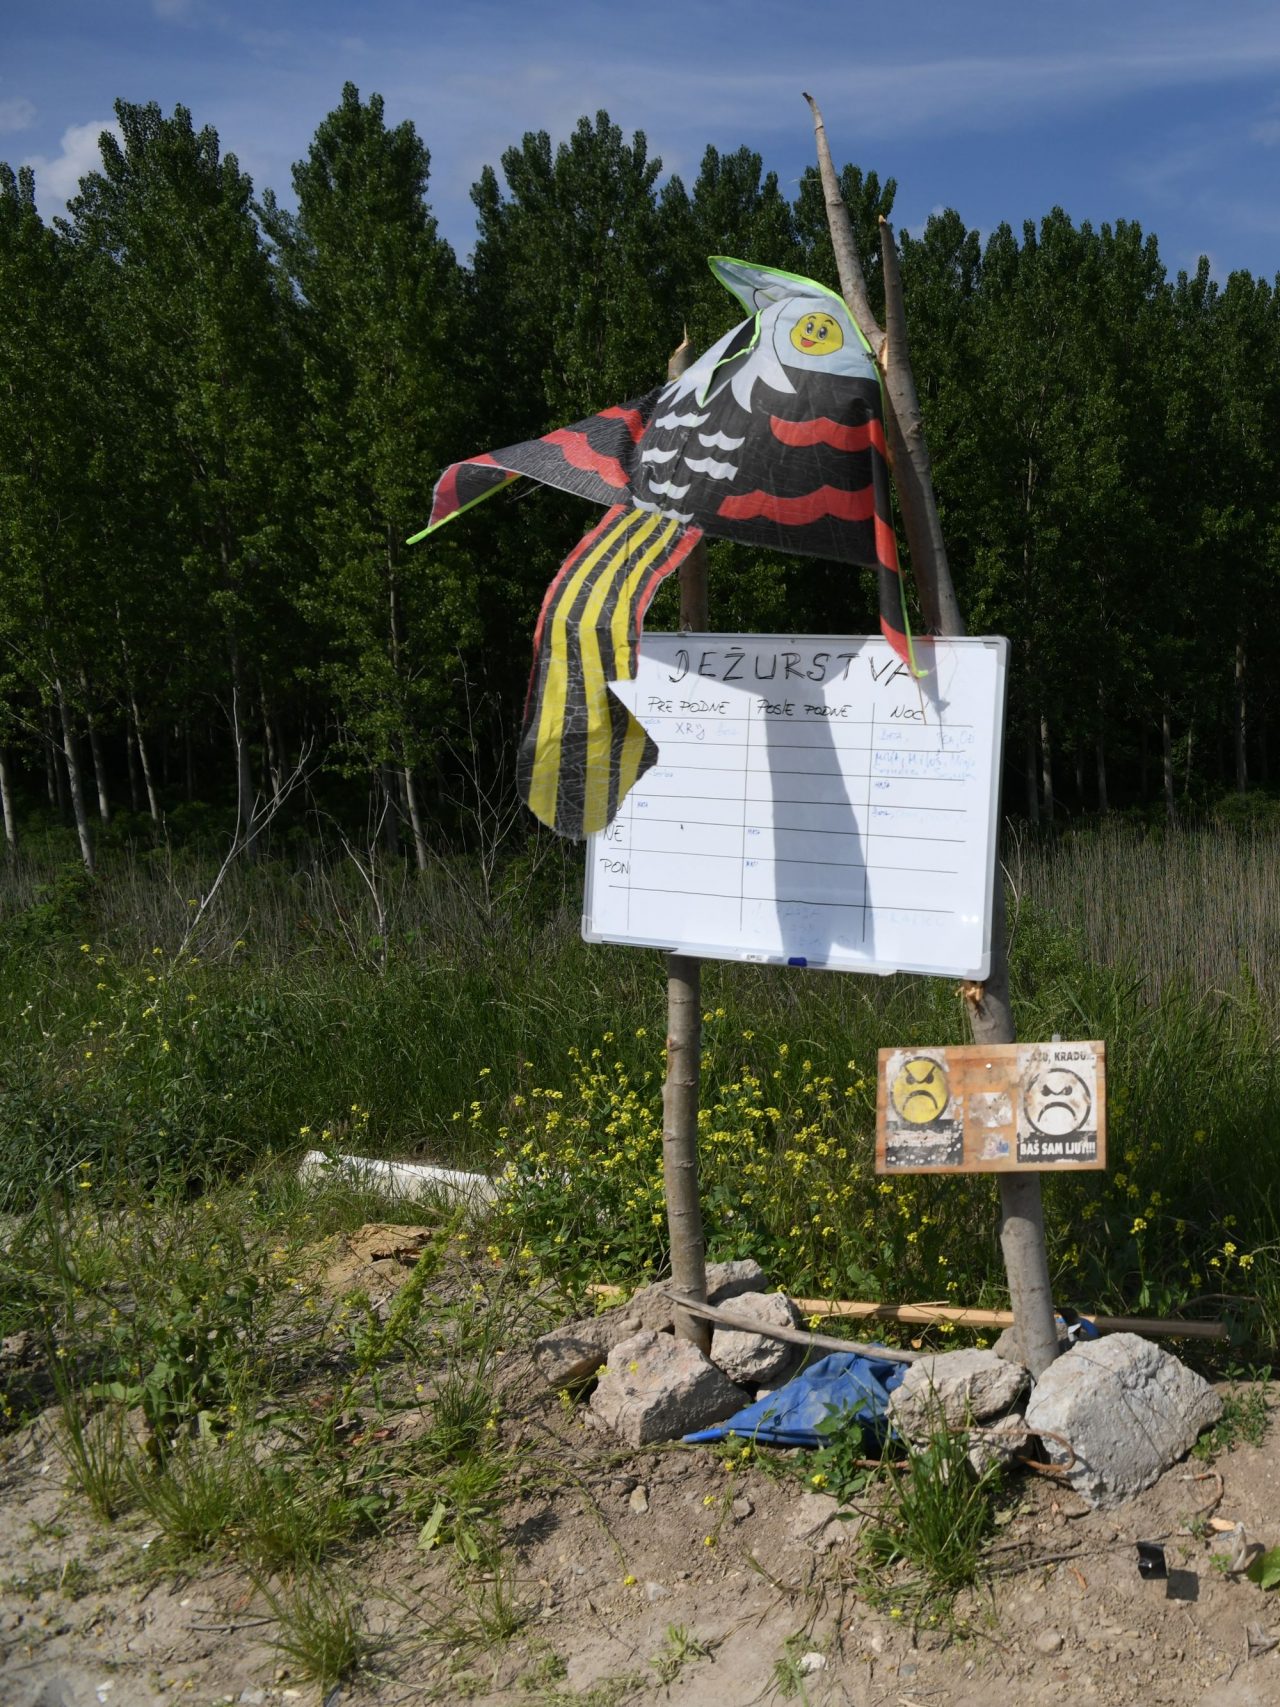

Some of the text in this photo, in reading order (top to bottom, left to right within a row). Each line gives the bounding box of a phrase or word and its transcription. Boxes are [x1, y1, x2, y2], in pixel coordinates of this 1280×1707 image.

[647, 696, 731, 715] PRE PODNE
[804, 704, 852, 718] PODNE
[600, 858, 629, 874] PON
[1020, 1139, 1039, 1155] BAŠ
[1041, 1141, 1063, 1155] SAM
